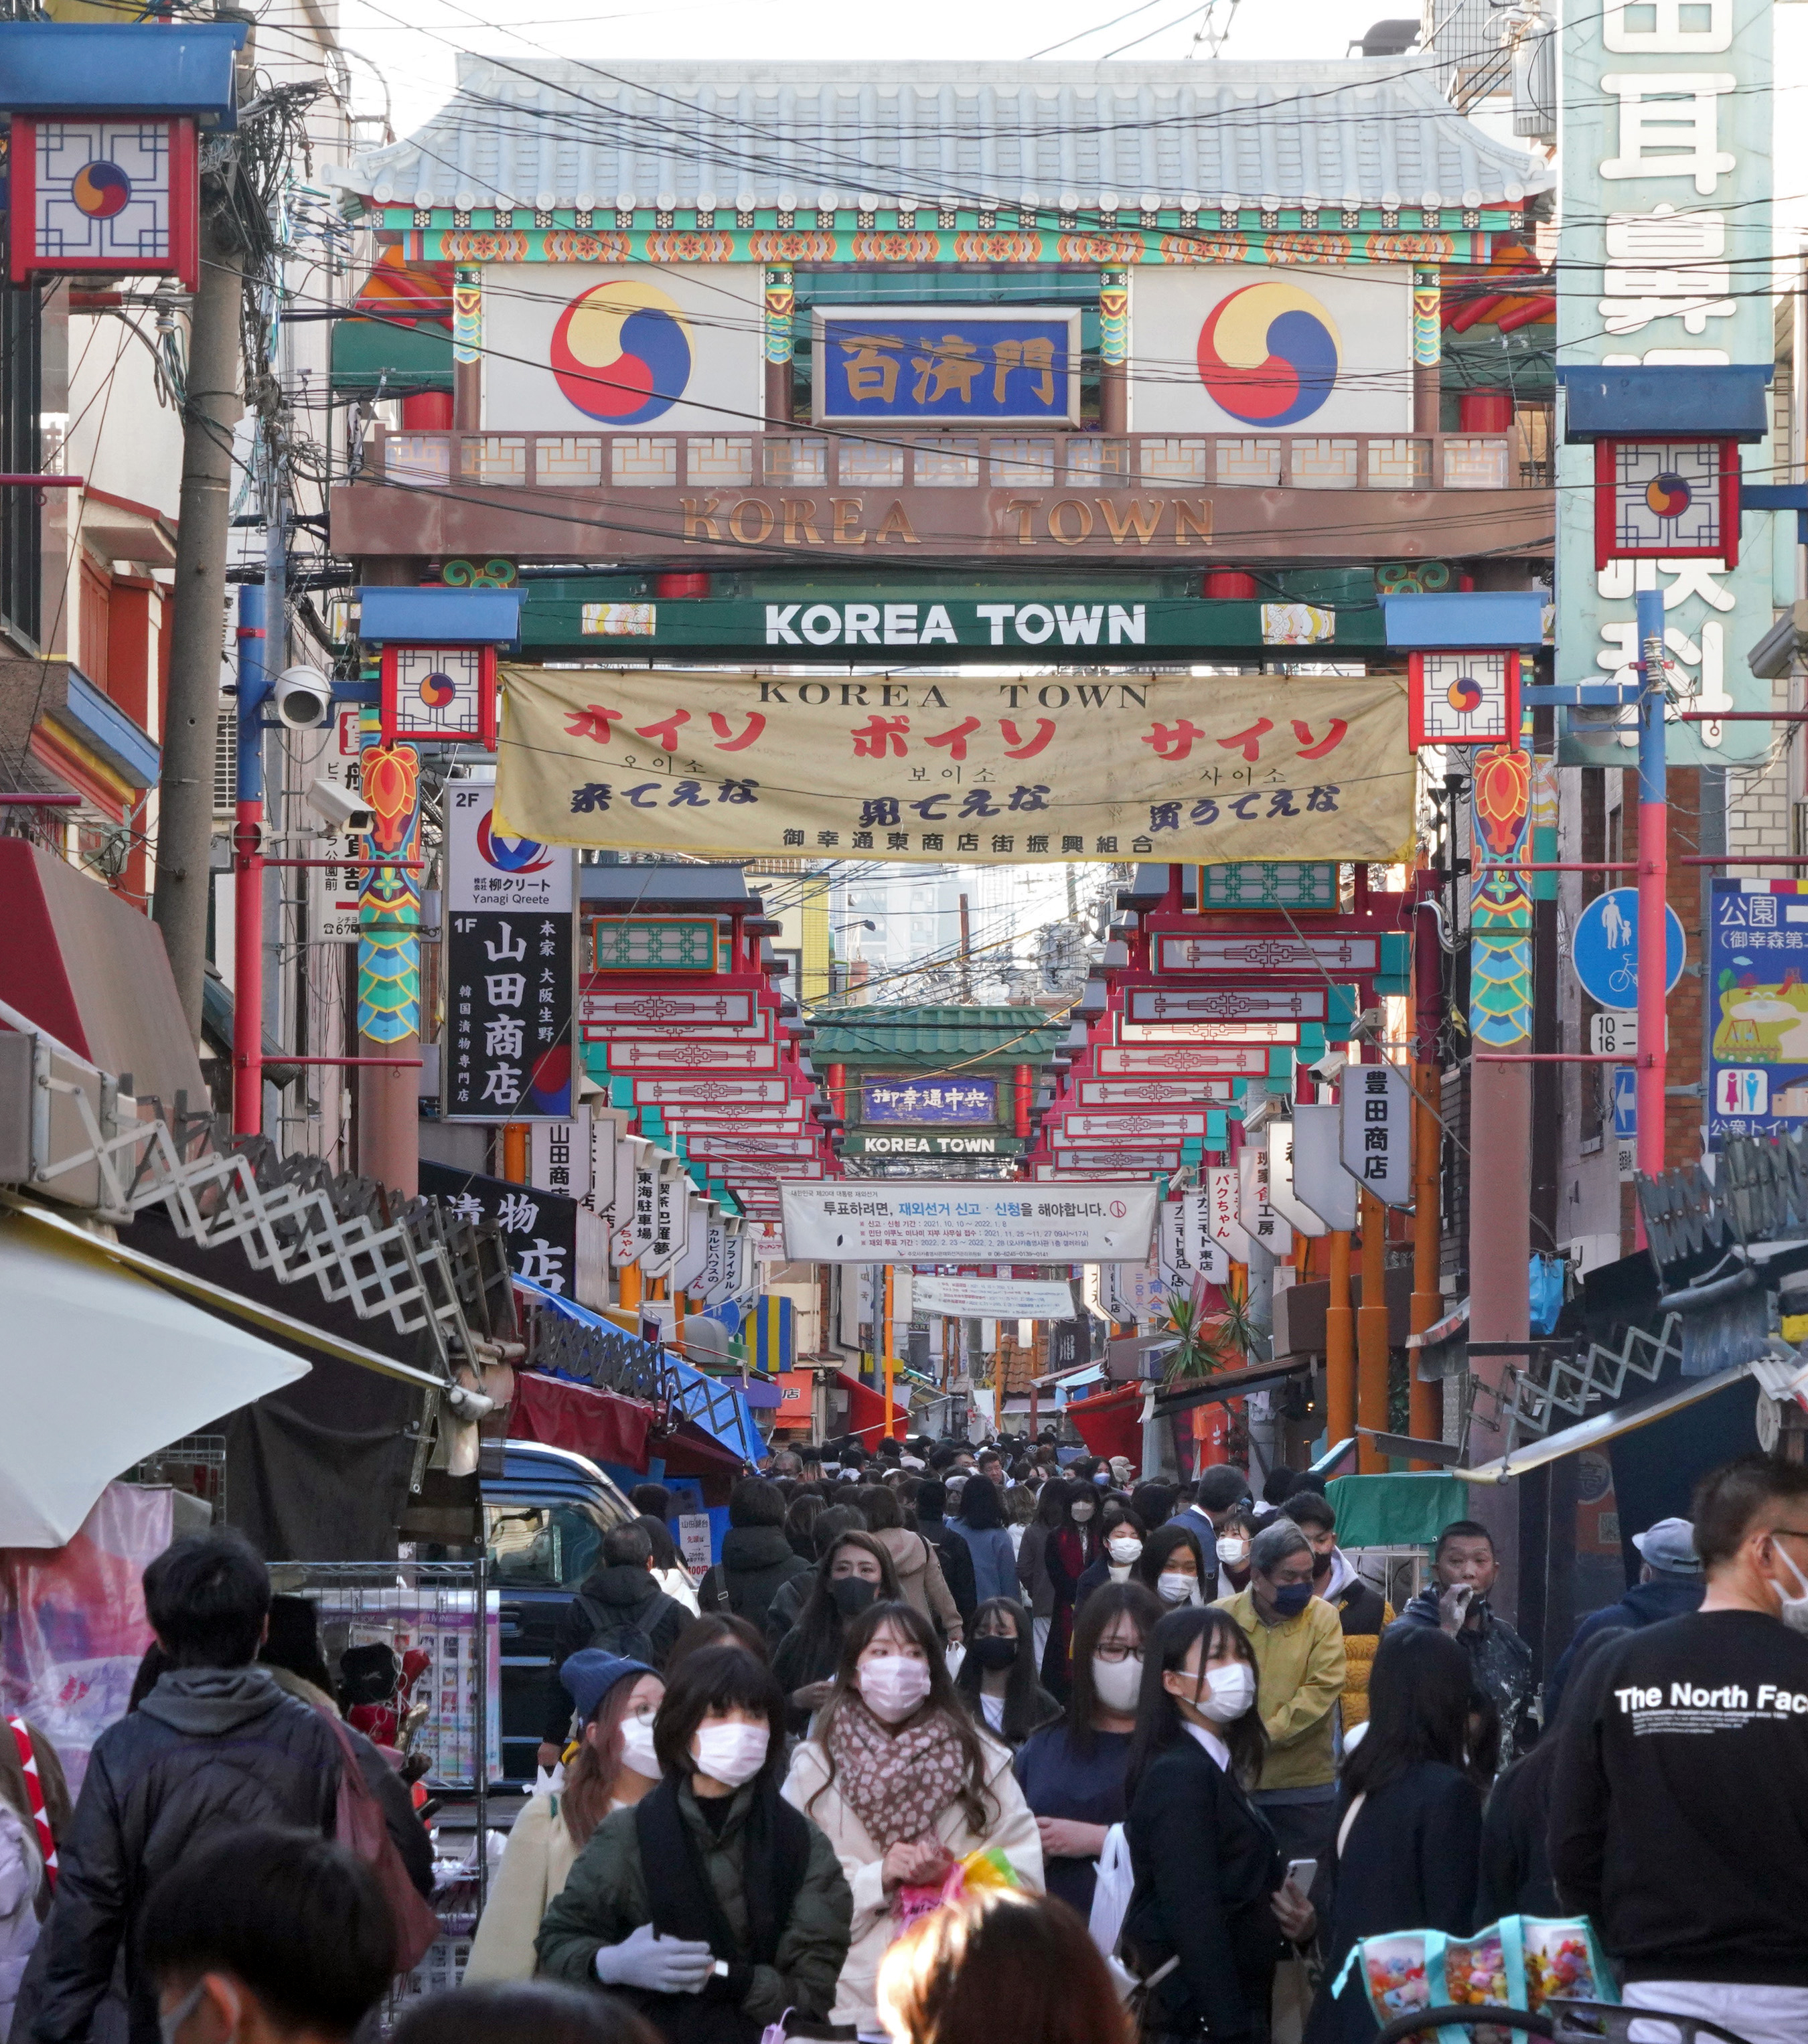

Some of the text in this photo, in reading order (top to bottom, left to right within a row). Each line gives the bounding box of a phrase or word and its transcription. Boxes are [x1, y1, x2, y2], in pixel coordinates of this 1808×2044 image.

[679, 498, 1213, 546] KOREA TOWN
[765, 605, 1146, 645] KOREA TOWN
[758, 682, 1150, 709] KOREA TOWN
[564, 704, 1348, 761] オイソ ボイソ サイソ
[624, 755, 1286, 786] 오이소 보이소 사이소
[456, 793, 479, 807] 2F
[570, 778, 1341, 832] 来てえな 見てえな 買うてえな
[783, 828, 1154, 853] 御幸通東商店街振興組合
[473, 894, 550, 905] Yanagi Qreete
[489, 878, 550, 892] 柳クリート
[336, 924, 357, 935] 67
[454, 919, 477, 933] 1F
[1720, 896, 1777, 927] 公園
[538, 920, 556, 1043] 本家 大阪生野
[480, 921, 526, 1106] 山田商店
[457, 985, 472, 1103] 韓国漬物専門店
[1364, 1071, 1388, 1179] 豊田商店
[864, 1137, 995, 1153] KOREA TOWN
[422, 1192, 540, 1233] 漬物
[637, 1172, 653, 1240] 東海駐車場
[824, 1202, 1106, 1217] 투표하려면, 재외선거 신고 신청을 해야합니다.
[1215, 1174, 1230, 1237] パクちゃん
[617, 1223, 633, 1257] ちゃん
[708, 1229, 719, 1282] カルビハウスの
[725, 1240, 737, 1289] ブライダル
[1614, 1686, 1662, 1713] The
[1670, 1682, 1748, 1709] North
